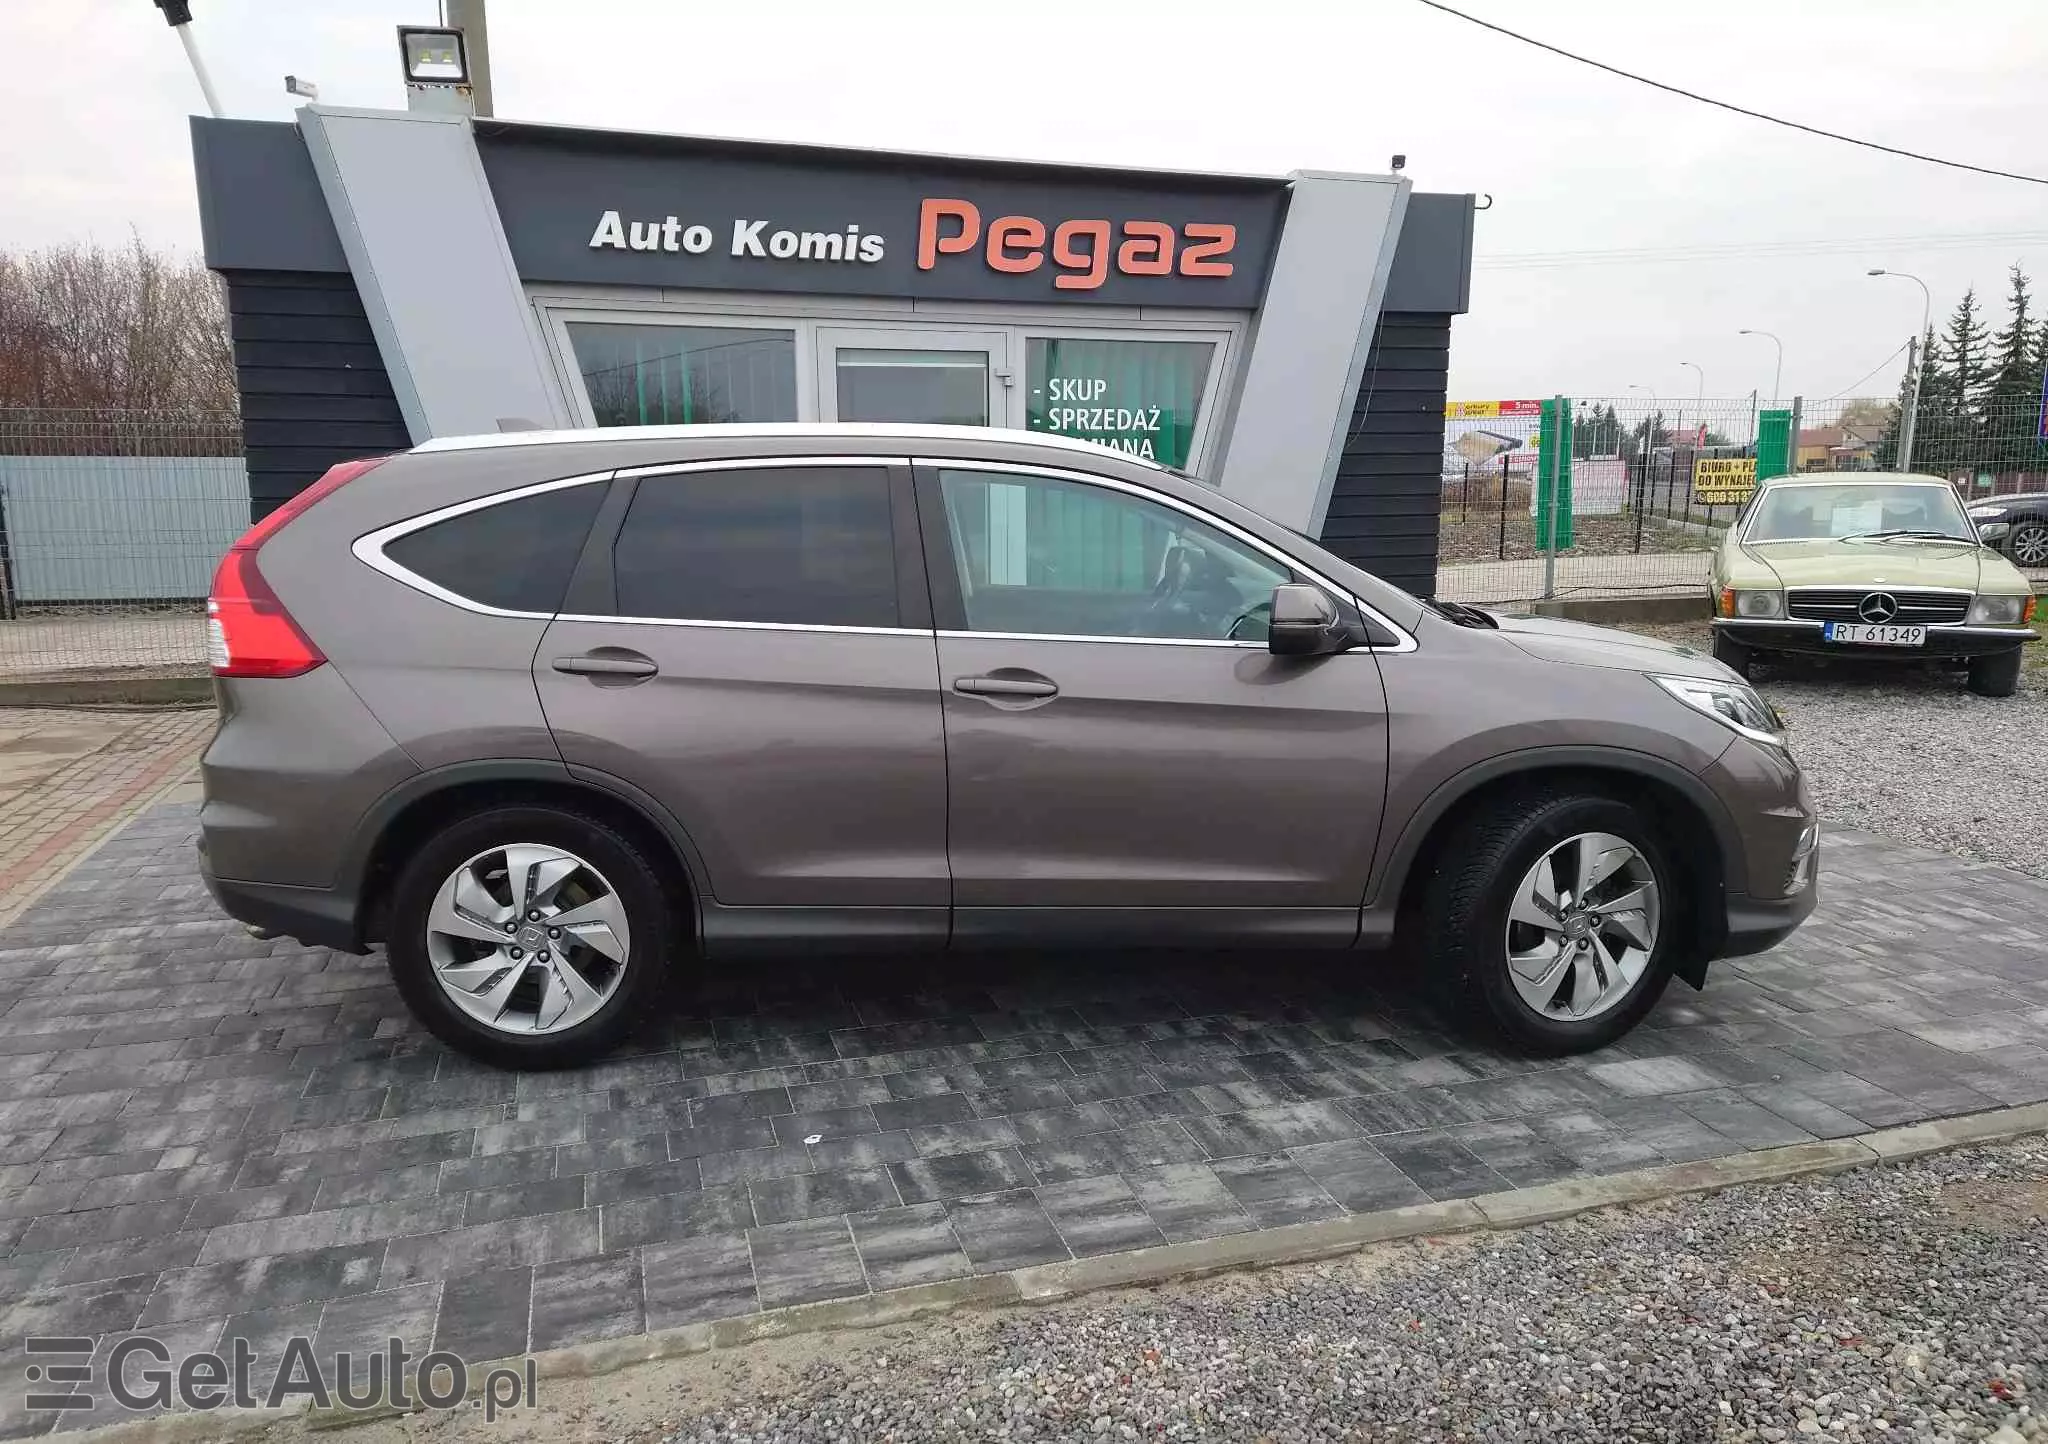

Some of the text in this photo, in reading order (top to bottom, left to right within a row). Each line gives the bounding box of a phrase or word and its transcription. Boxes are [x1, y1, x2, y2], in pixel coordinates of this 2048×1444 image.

[588, 197, 1237, 290] Auto Komis Pegaz
[1048, 378, 1107, 401] SKUP
[1048, 404, 1161, 431] SPRZEDAŻ
[1700, 462, 1731, 473] BIURO
[1698, 475, 1712, 486] DO
[1836, 624, 1921, 642] RT 61349
